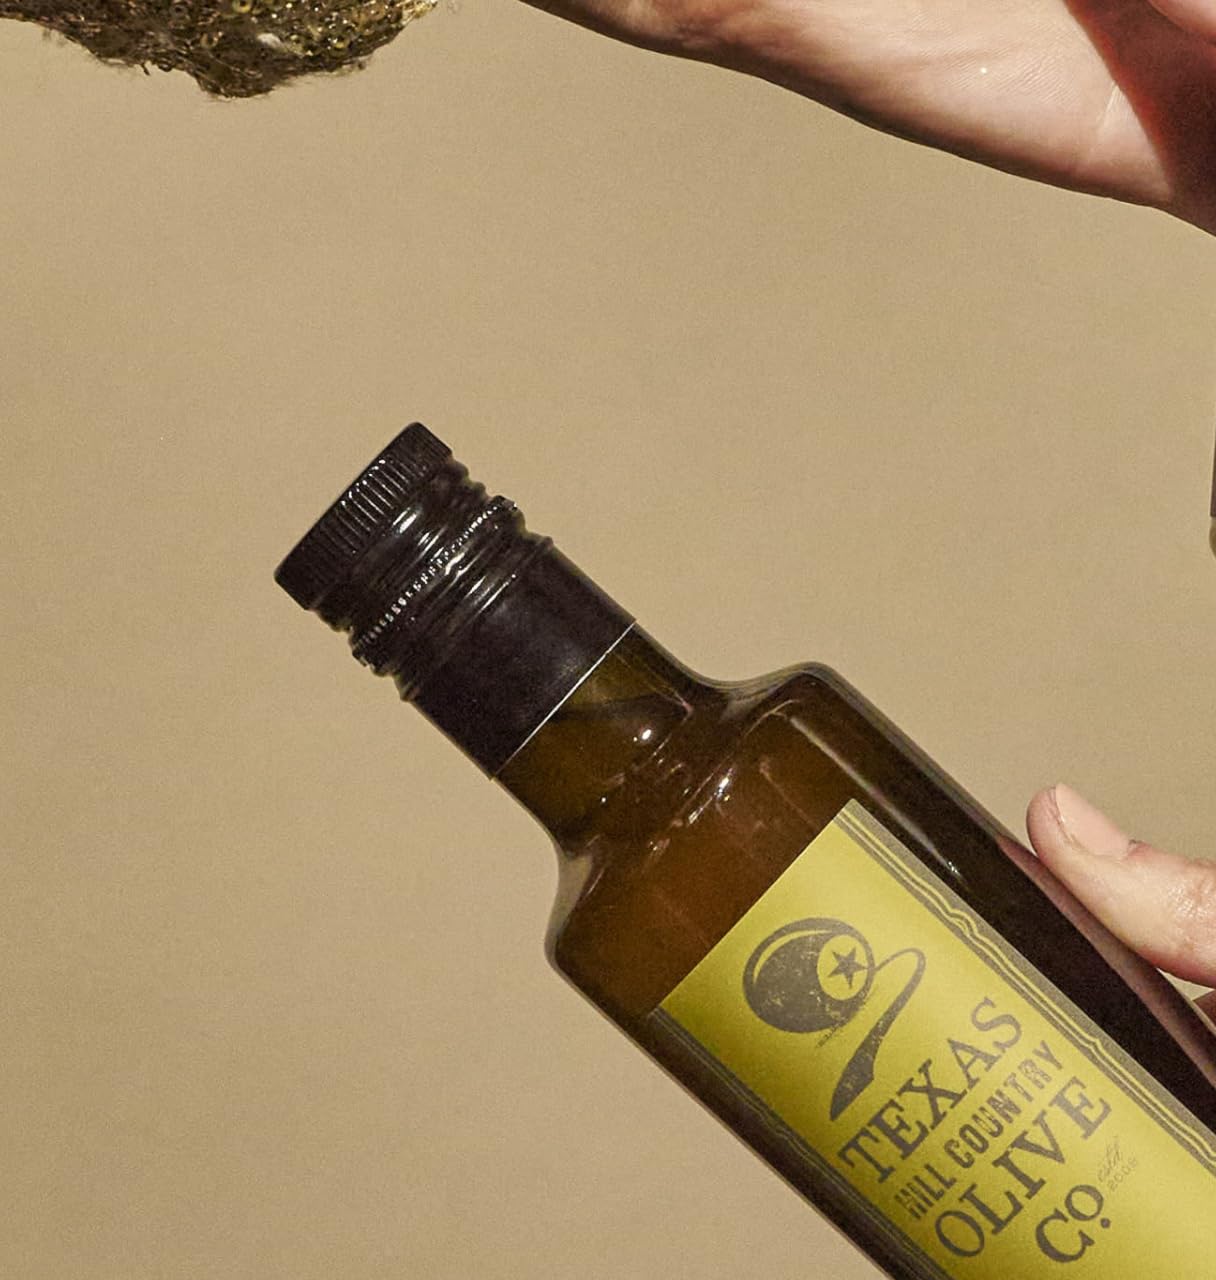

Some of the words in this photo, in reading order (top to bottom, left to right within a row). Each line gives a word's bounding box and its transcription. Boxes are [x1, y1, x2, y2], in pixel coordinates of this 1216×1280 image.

[838, 997, 1022, 1184] TEXAS
[894, 1163, 957, 1221] HILL
[944, 1040, 1062, 1169] COUNTRY
[935, 1076, 1112, 1259] OLIVE
